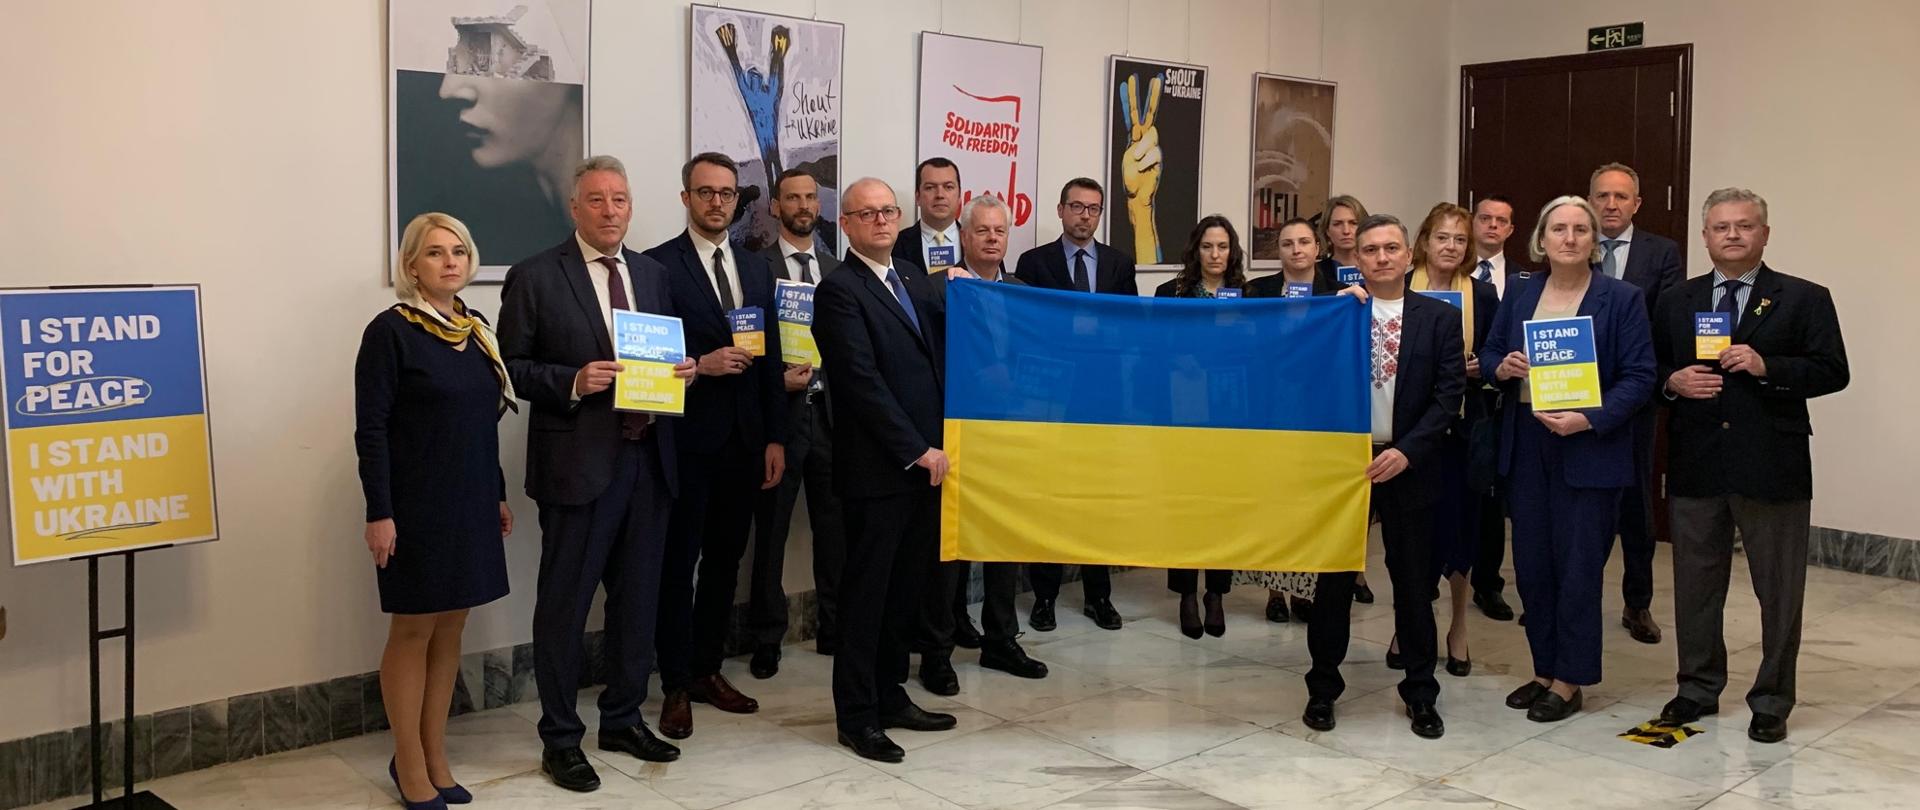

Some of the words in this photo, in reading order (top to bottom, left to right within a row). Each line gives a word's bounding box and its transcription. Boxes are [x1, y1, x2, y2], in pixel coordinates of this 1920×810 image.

[1165, 69, 1197, 87] SHOUT
[1172, 85, 1201, 99] UKRAINE
[945, 111, 1019, 143] SOLIDARITY
[943, 129, 964, 150] FOR
[966, 137, 1018, 157] FREEDOM
[1347, 273, 1364, 281] STA
[781, 289, 785, 297] I
[786, 290, 814, 303] STAN
[780, 299, 799, 310] FOR
[778, 308, 811, 321] PEACE
[21, 319, 32, 345] I
[40, 315, 161, 344] STAND
[628, 322, 669, 336] STAND
[1533, 331, 1537, 340] I
[1538, 327, 1579, 339] STAND
[624, 333, 647, 344] FOR
[1534, 340, 1557, 351] FOR
[1535, 350, 1575, 362] PEACE
[23, 349, 94, 378] FOR
[25, 379, 145, 412] PEACE
[29, 443, 40, 469] I
[48, 432, 169, 467] STAND
[31, 469, 124, 503] WITH
[34, 494, 190, 537] UKRAINE
